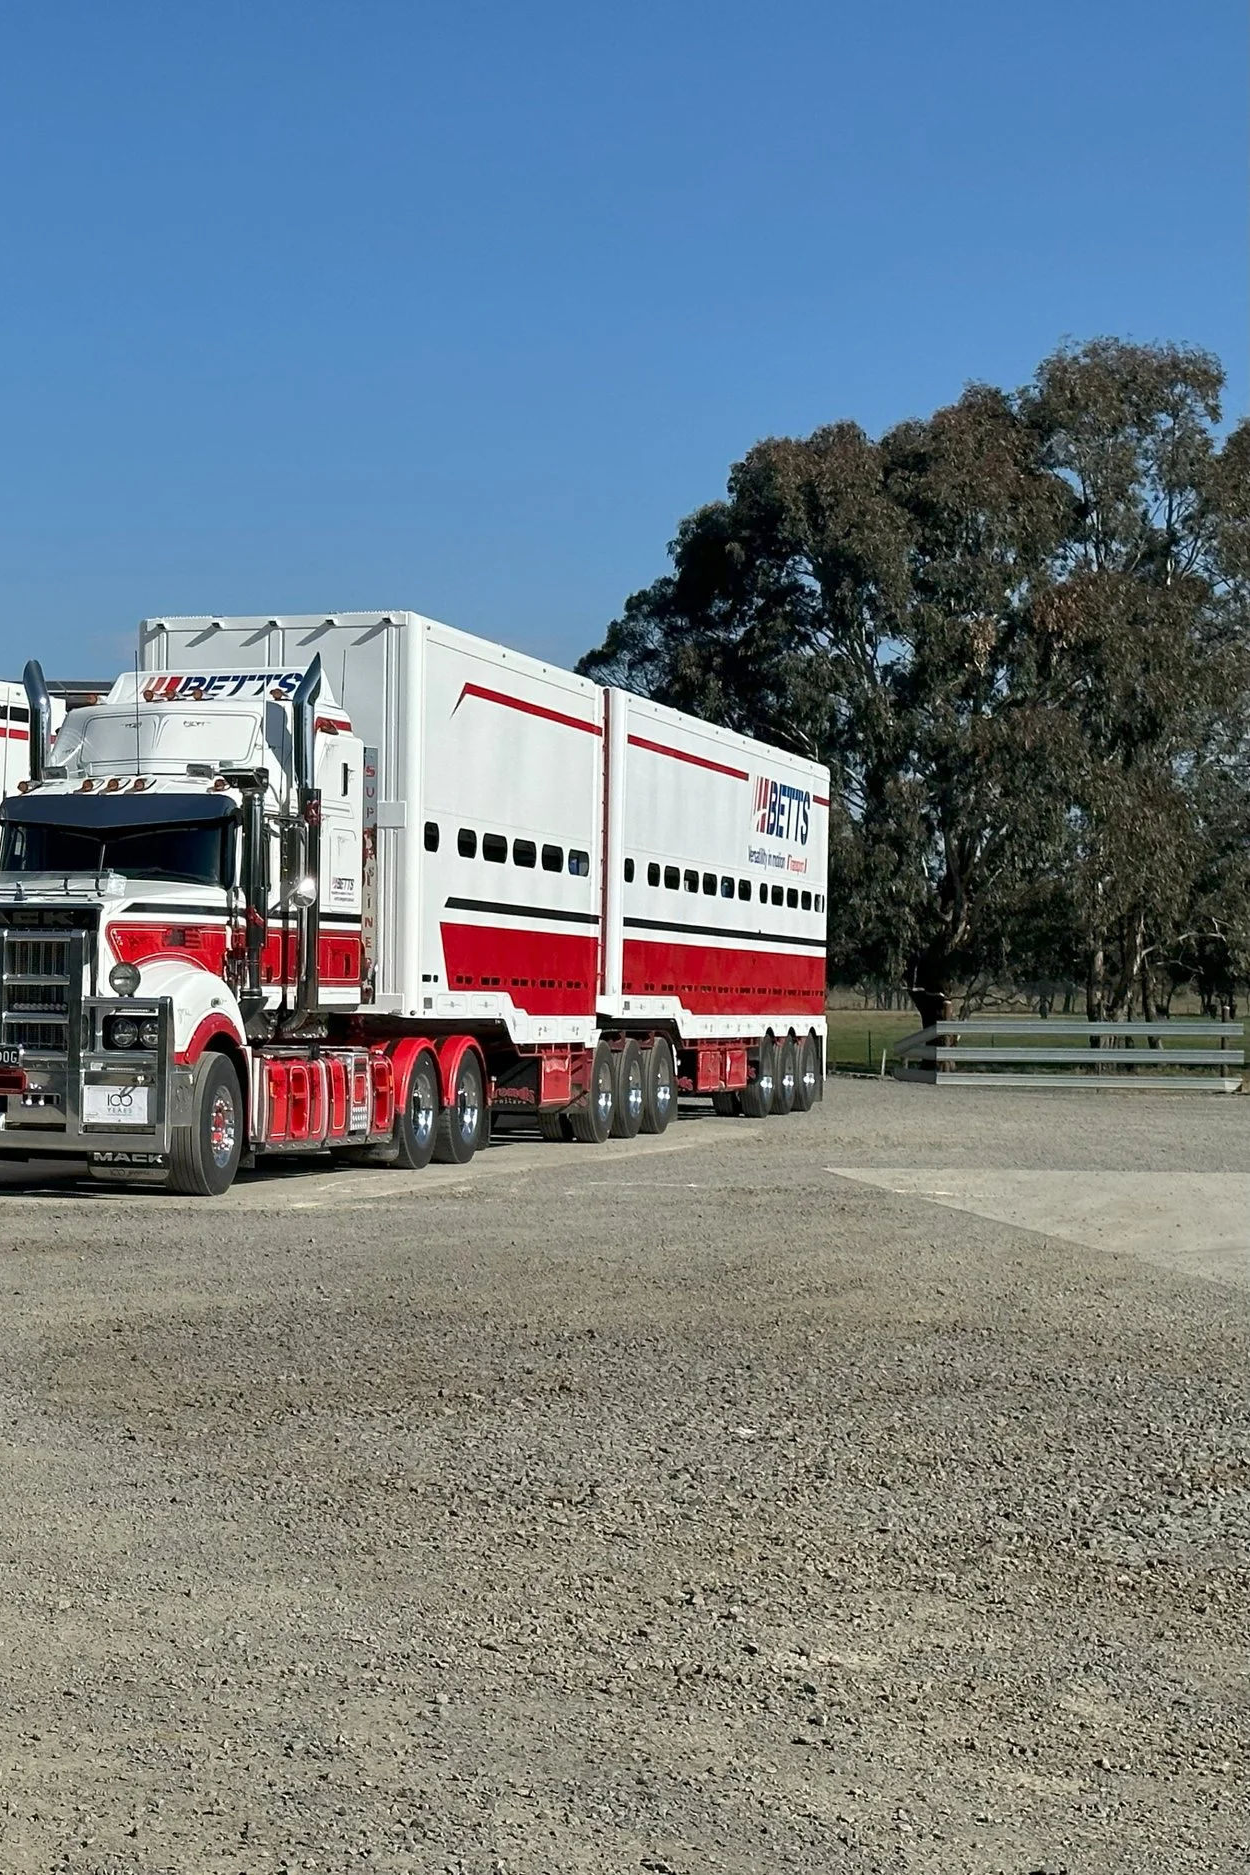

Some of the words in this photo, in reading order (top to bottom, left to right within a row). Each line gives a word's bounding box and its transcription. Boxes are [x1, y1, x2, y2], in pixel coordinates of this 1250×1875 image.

[179, 673, 304, 698] BETTS
[766, 780, 810, 846] BETTS
[107, 1094, 133, 1107] 100
[93, 1152, 163, 1163] MACK
